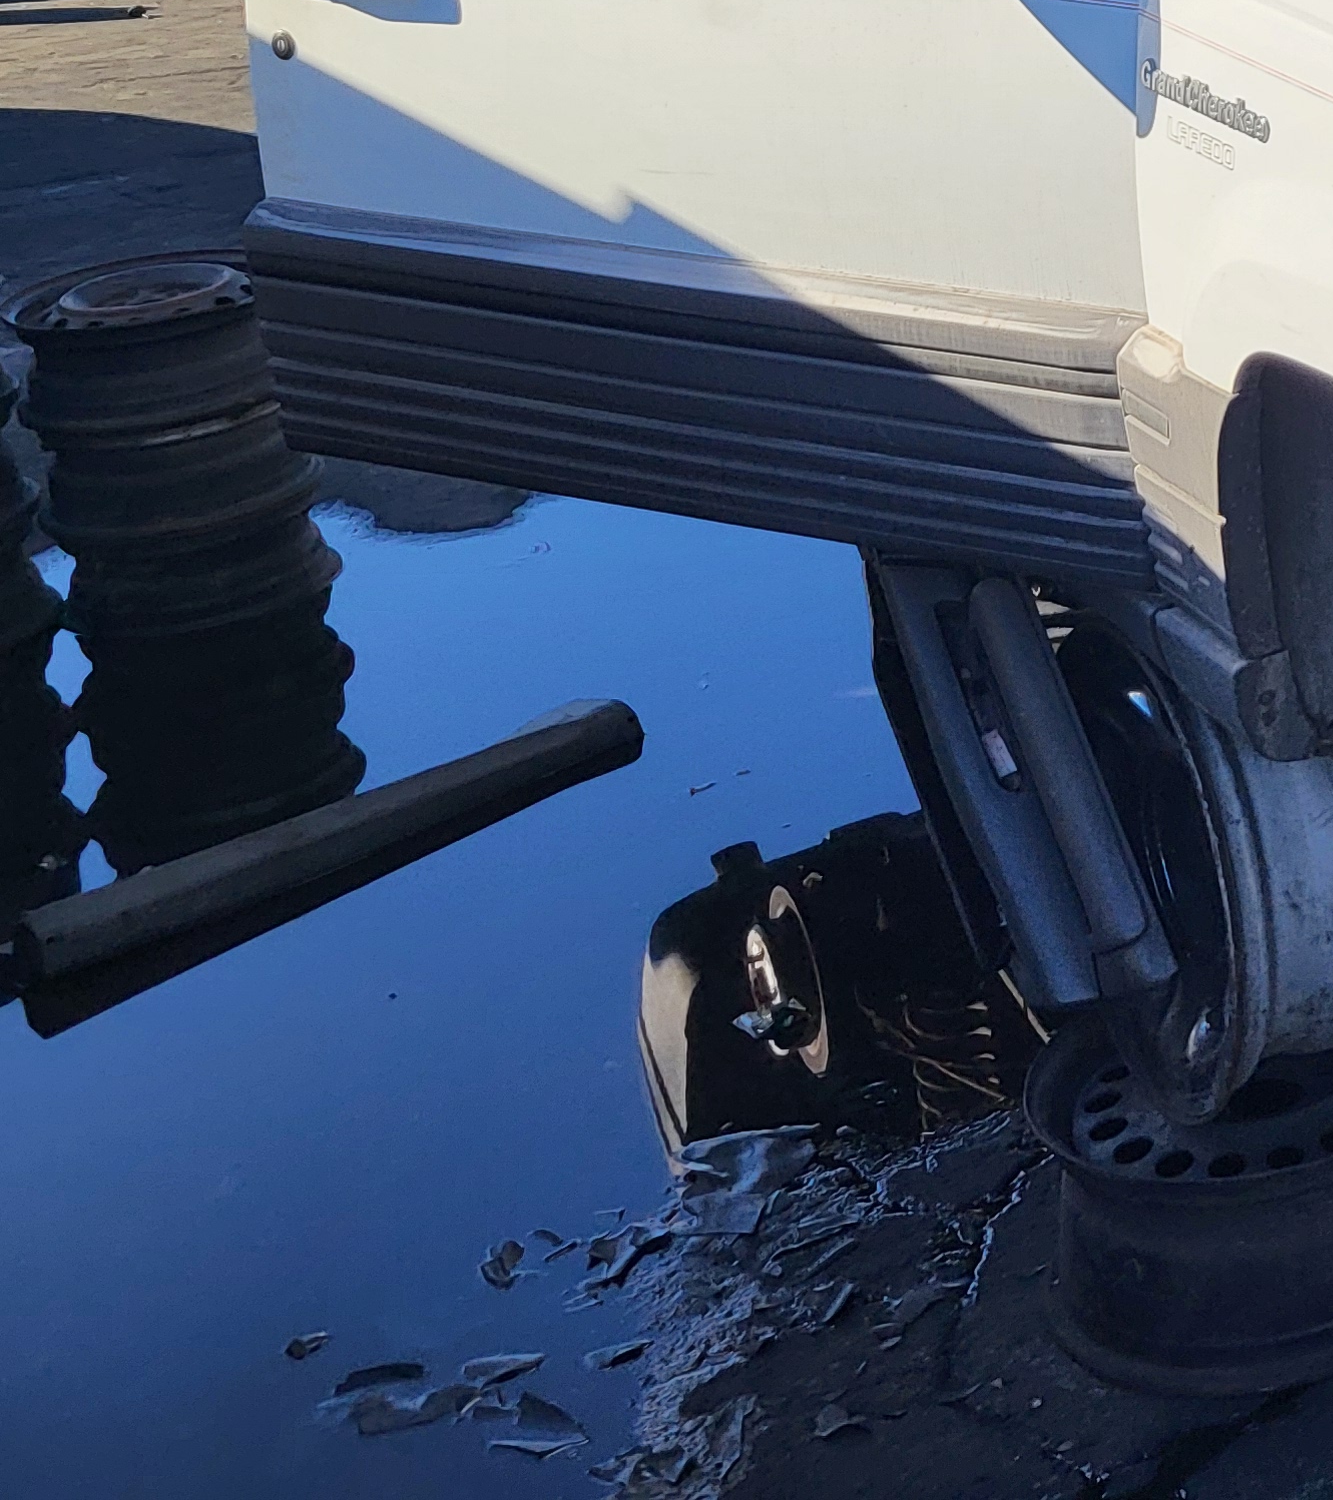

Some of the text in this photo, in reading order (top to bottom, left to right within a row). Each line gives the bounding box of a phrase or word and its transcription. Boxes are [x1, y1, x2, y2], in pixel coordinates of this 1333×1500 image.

[1141, 58, 1271, 143] Grand Cherokee
[1166, 115, 1235, 171] LAREDO
